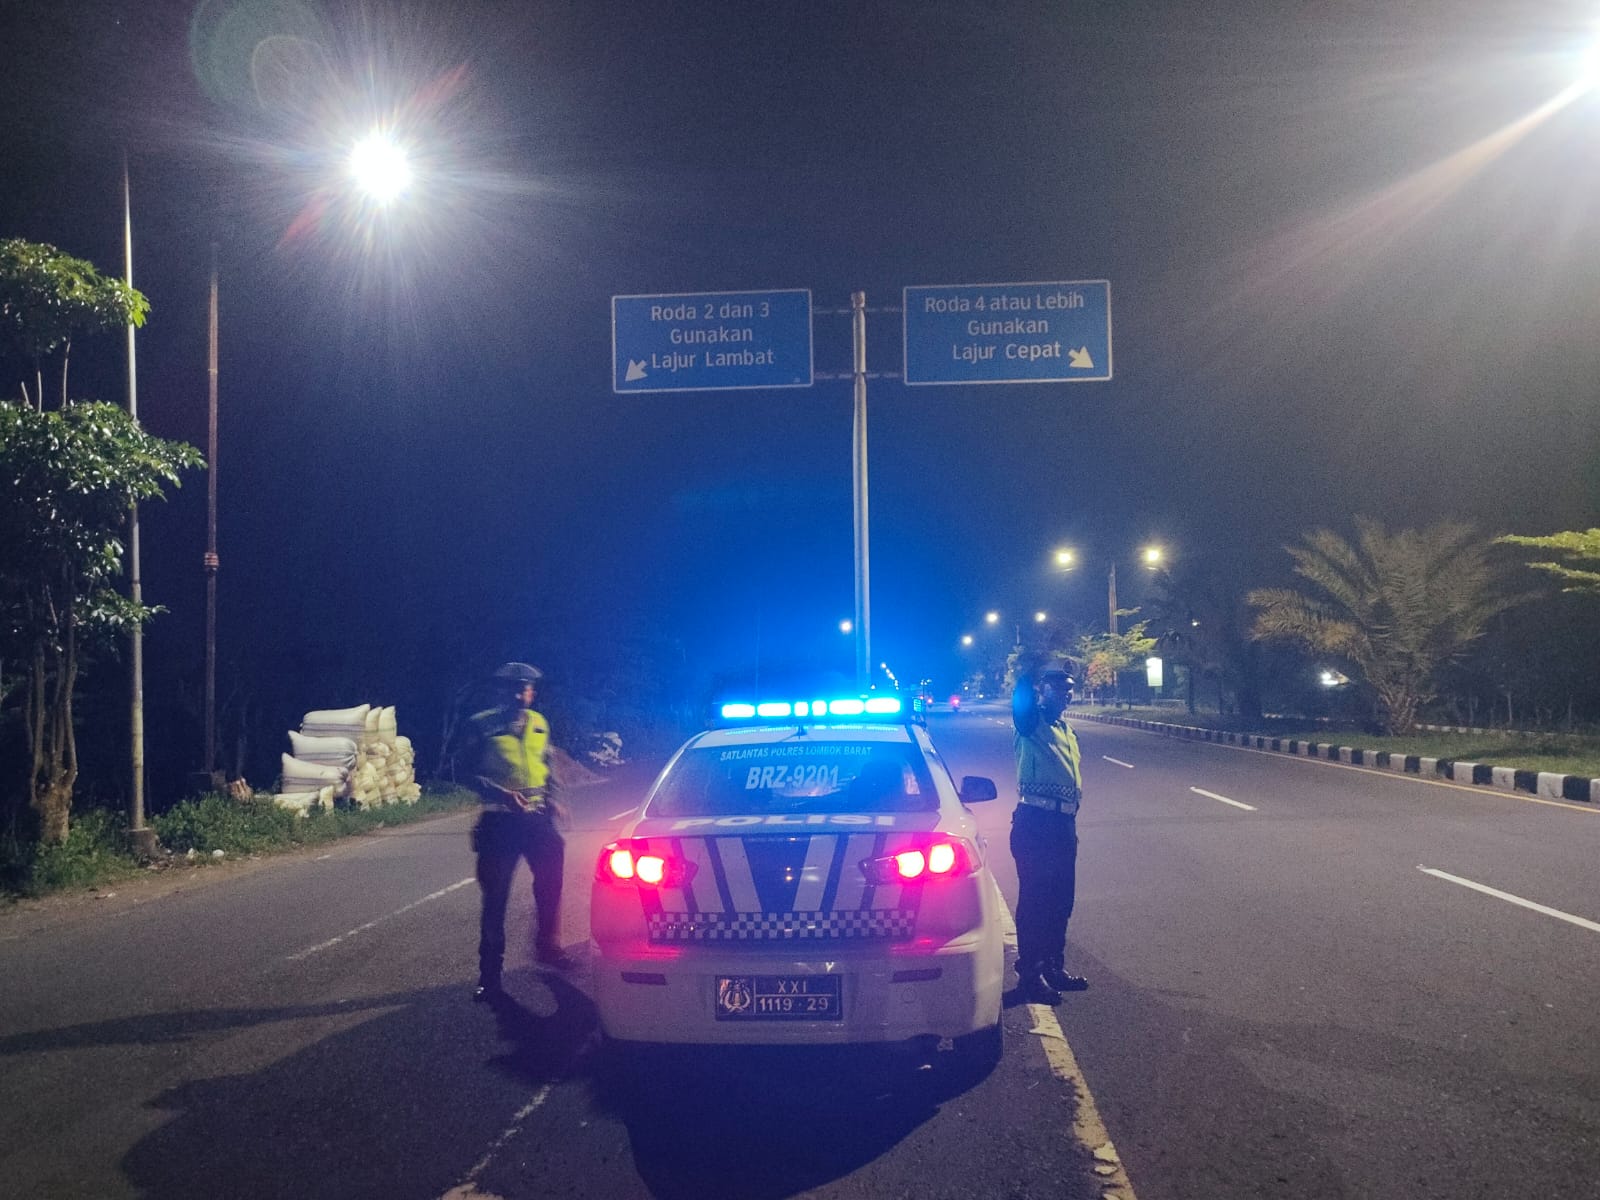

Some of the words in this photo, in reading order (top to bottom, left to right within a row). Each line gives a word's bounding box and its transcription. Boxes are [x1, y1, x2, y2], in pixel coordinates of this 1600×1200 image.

[651, 304, 697, 321] Roda
[704, 304, 714, 319] 2
[719, 303, 753, 318] dan
[760, 302, 770, 318] 3
[925, 296, 970, 312] Roda
[975, 296, 986, 311] 4
[990, 297, 1031, 311] atau
[1036, 292, 1084, 309] Lebih
[670, 326, 753, 344] Gunakan
[967, 318, 1049, 335] Gunakan
[652, 353, 696, 372] Lajur
[705, 349, 774, 367] Lambat
[953, 344, 996, 364] Lajur
[1005, 342, 1061, 361] Cepat
[720, 748, 769, 761] SATLANTAS
[770, 746, 803, 757] POLRES
[805, 745, 841, 755] LOMBOK
[844, 746, 873, 756] BARAT
[745, 764, 839, 790] BRZ-9201
[670, 814, 897, 831] POLISI
